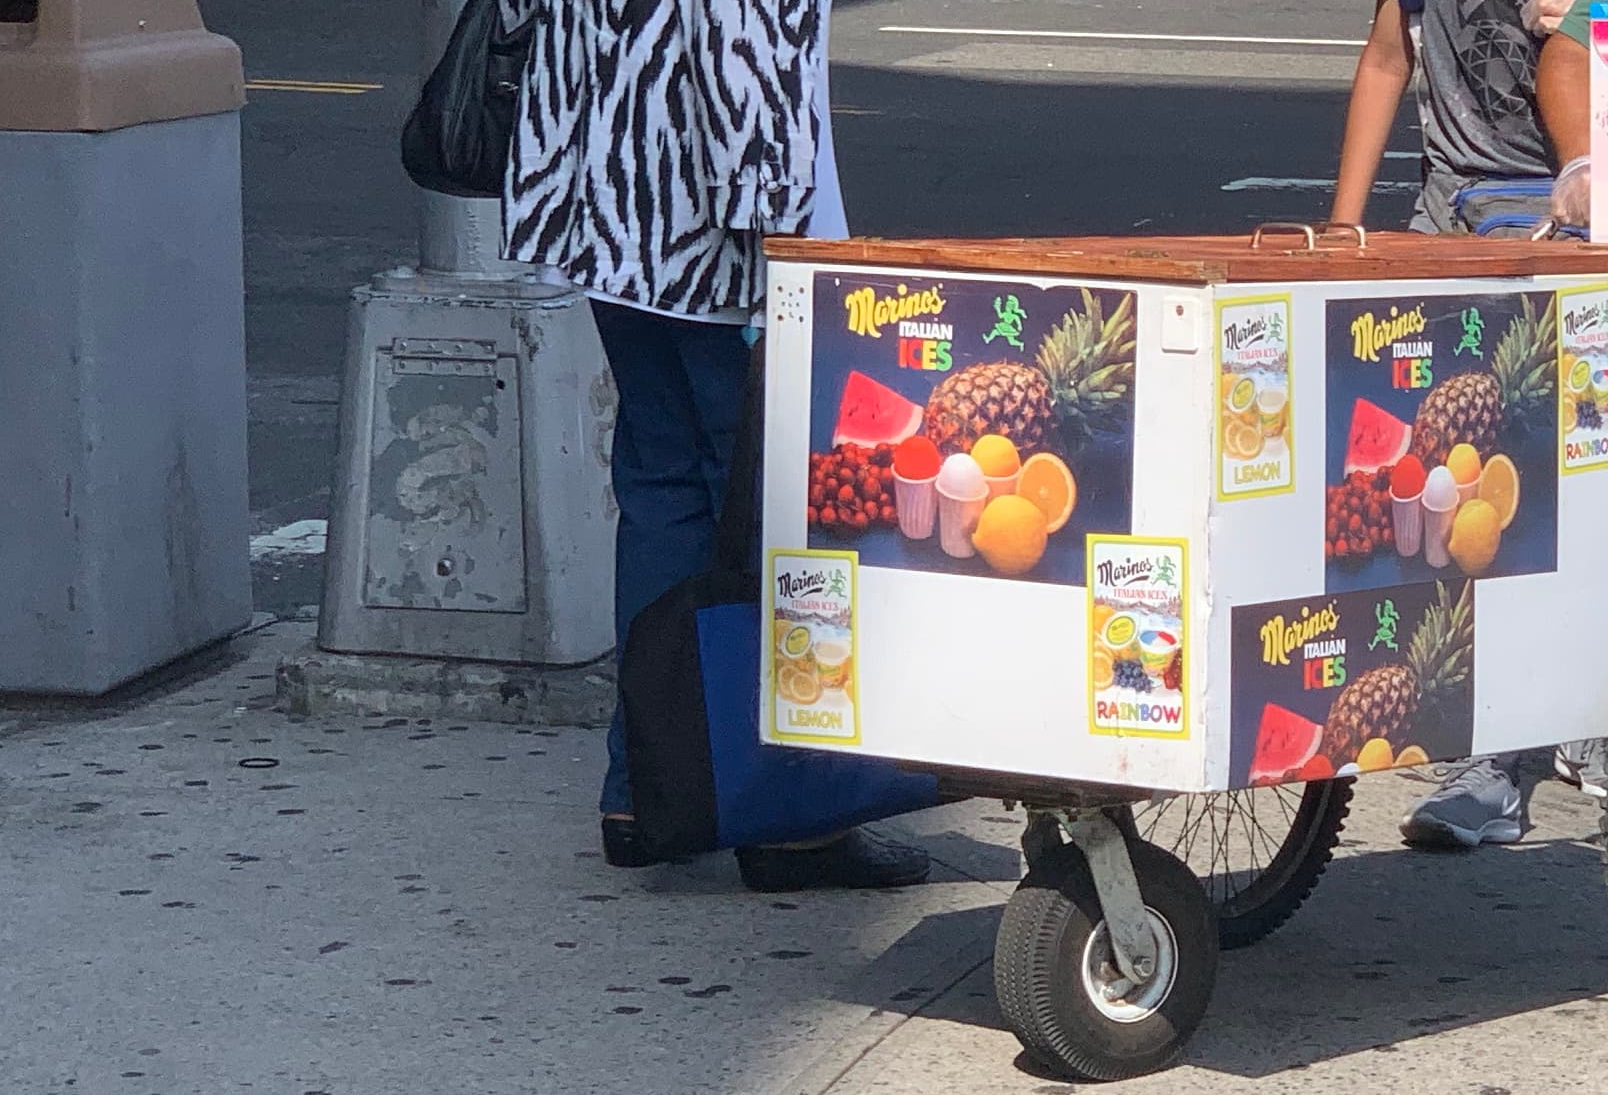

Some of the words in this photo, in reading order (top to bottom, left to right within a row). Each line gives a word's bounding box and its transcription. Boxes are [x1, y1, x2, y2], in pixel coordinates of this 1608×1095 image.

[899, 321, 953, 341] ITALIAN
[898, 338, 953, 372] ICES
[1392, 341, 1433, 358] ITALIAN
[1392, 358, 1433, 389] ICES
[1234, 461, 1281, 485] LEMON
[1303, 638, 1346, 659] ITALIAN
[1303, 656, 1347, 690] ICES
[788, 709, 844, 730] LEMON
[1097, 701, 1182, 724] RAINBOW
